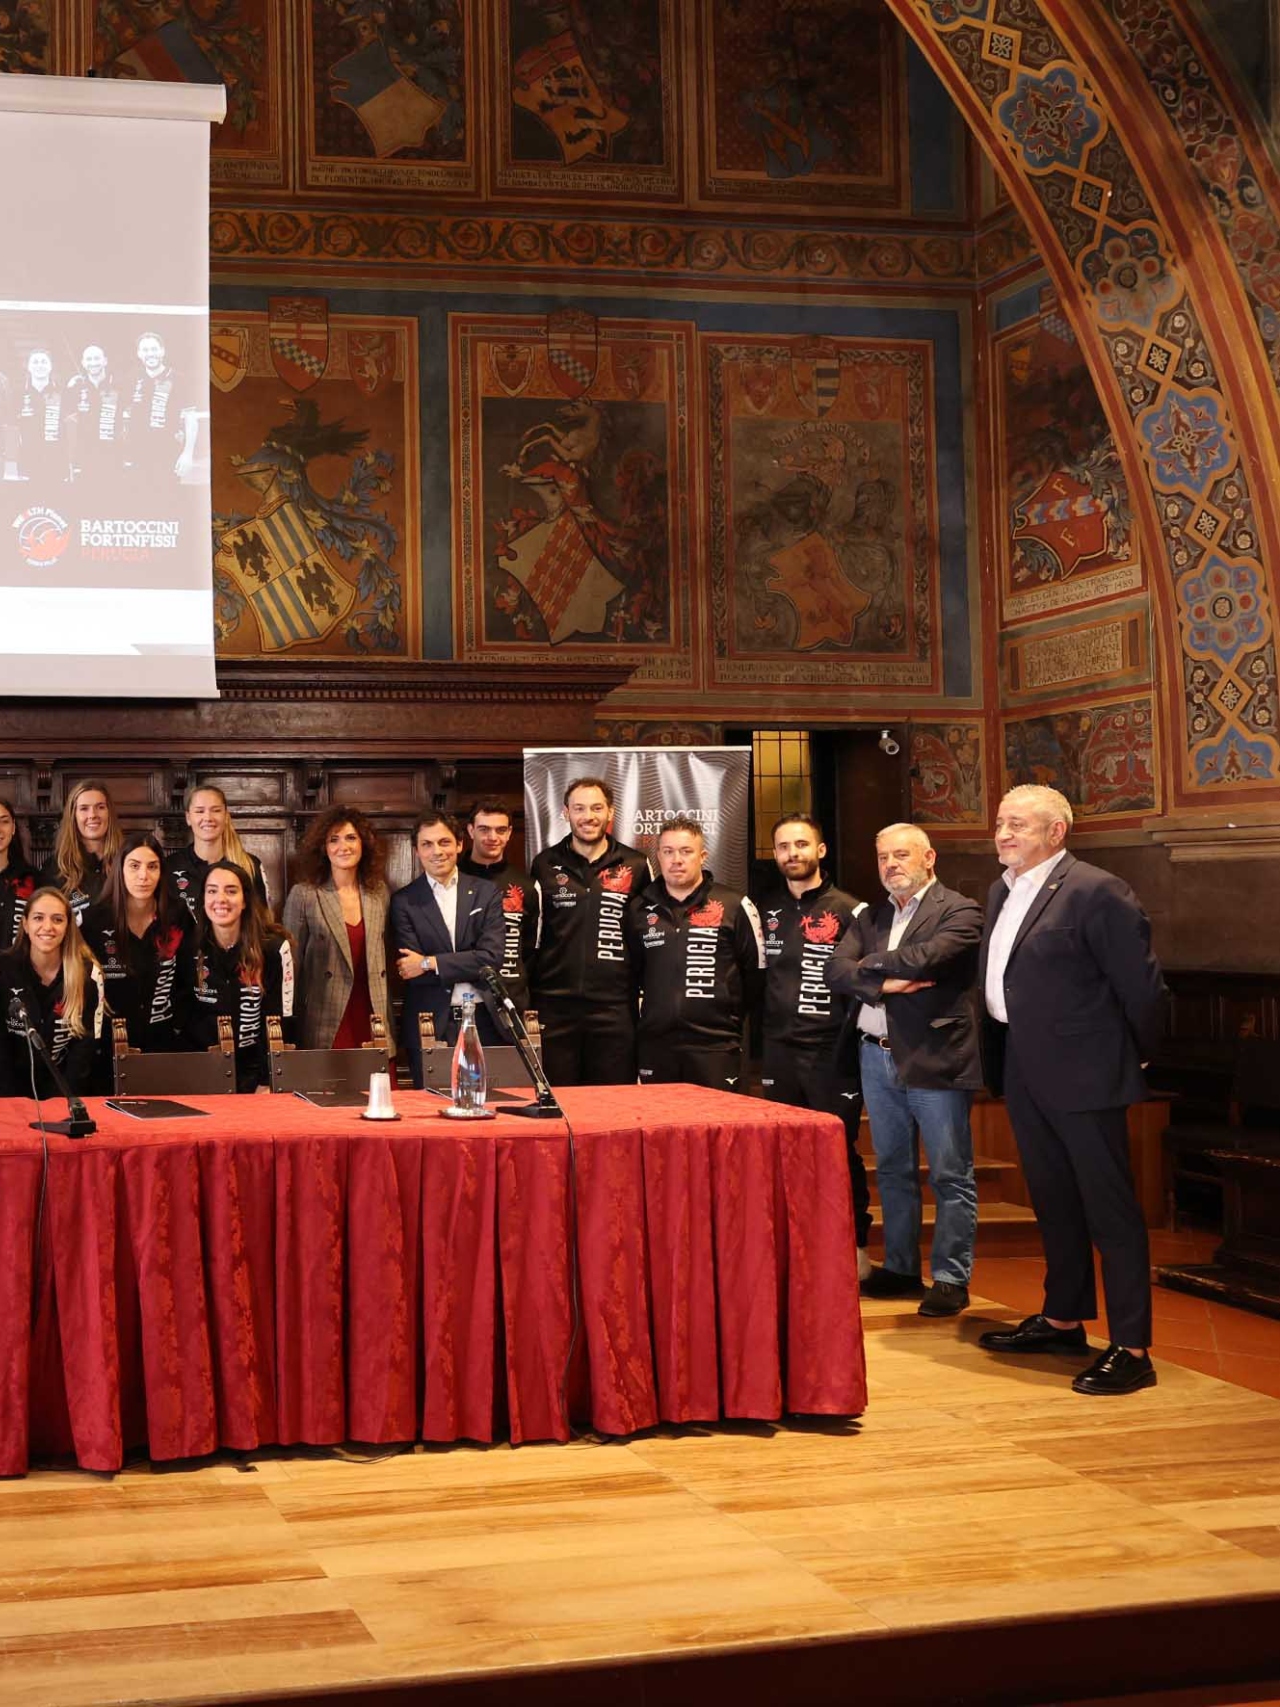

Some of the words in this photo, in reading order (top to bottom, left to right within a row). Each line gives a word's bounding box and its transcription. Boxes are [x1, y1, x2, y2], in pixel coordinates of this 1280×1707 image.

[80, 519, 179, 535] BARTOCCINI
[80, 533, 179, 548] FORTINFISSI
[499, 912, 524, 978] PERUGIA
[597, 892, 629, 961] PERUGIA
[685, 927, 719, 998] PERUGIA
[797, 943, 835, 1016] PERUGIA
[239, 985, 263, 1048] PERUGIA
